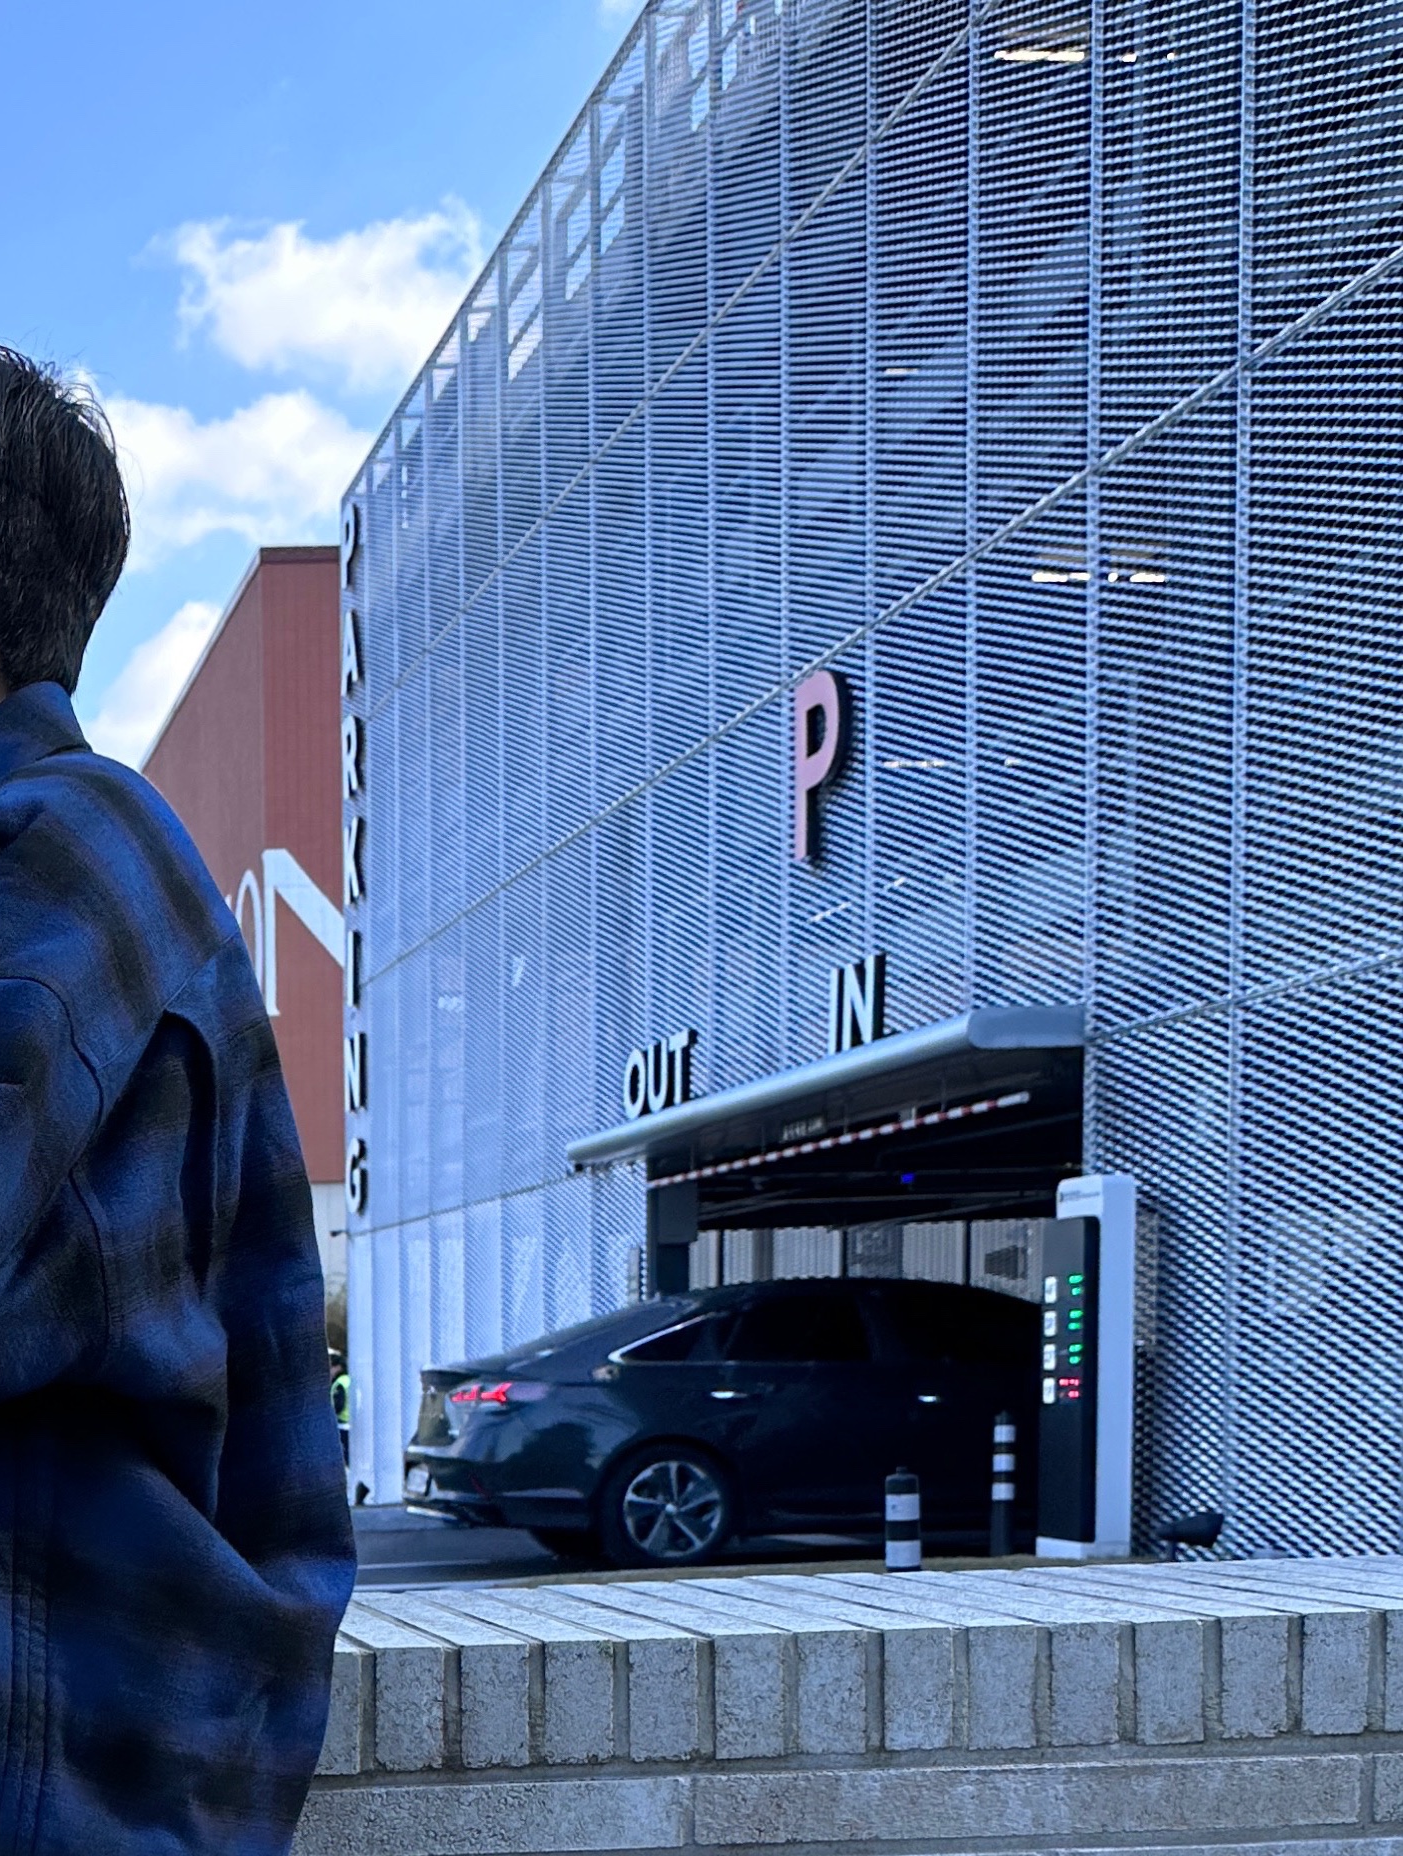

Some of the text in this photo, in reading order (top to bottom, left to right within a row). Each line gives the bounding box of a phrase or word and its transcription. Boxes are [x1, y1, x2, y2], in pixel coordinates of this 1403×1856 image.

[794, 669, 842, 861] P
[340, 501, 365, 1216] PARKING
[623, 1028, 693, 1119] OUT
[828, 953, 882, 1054] IN
